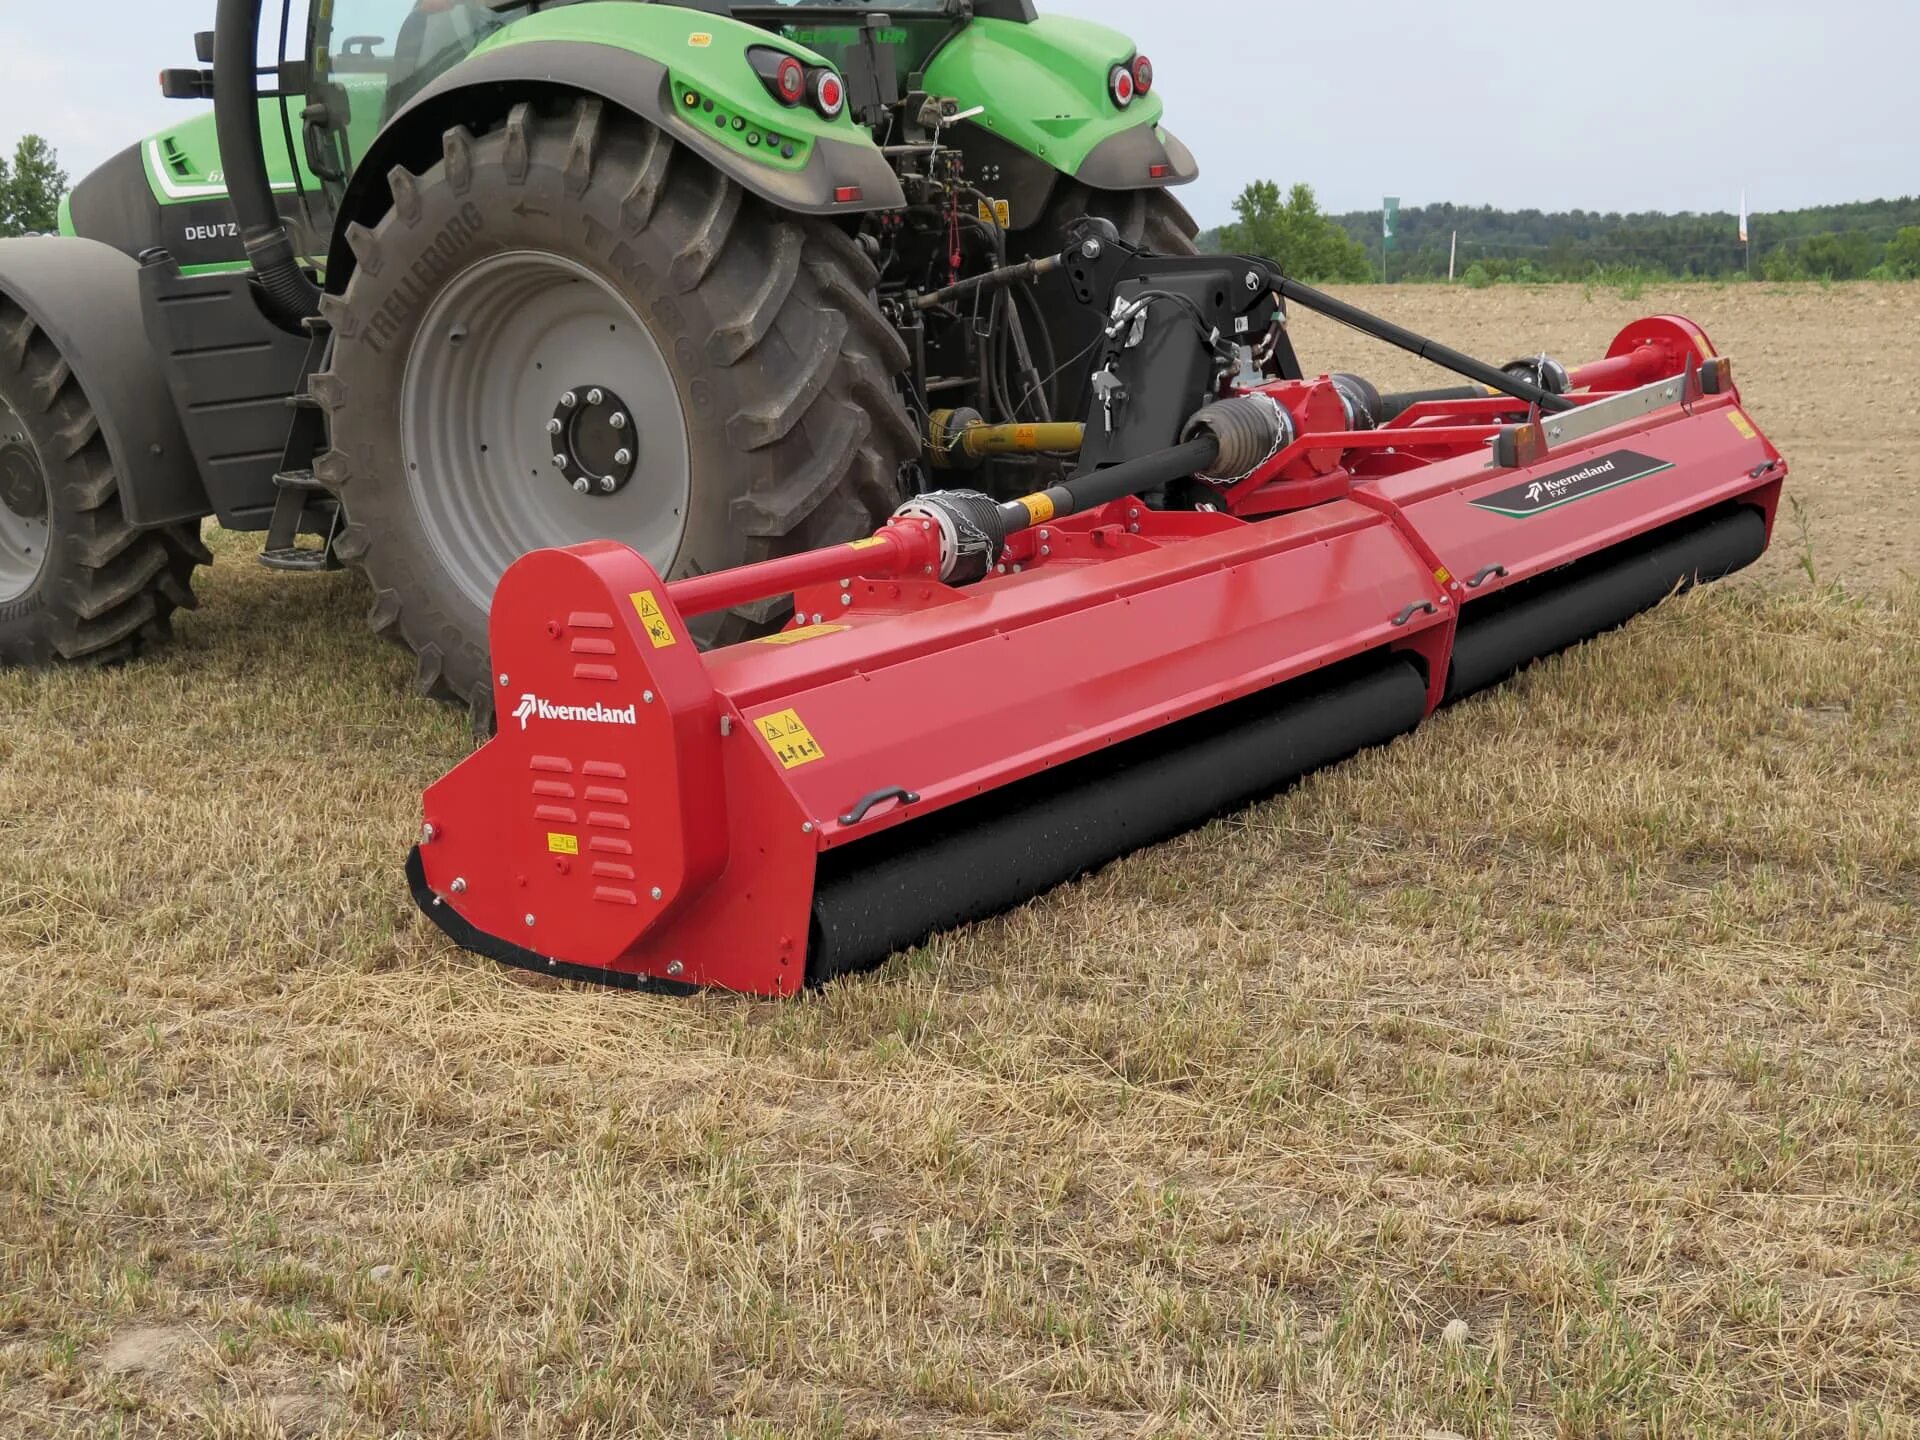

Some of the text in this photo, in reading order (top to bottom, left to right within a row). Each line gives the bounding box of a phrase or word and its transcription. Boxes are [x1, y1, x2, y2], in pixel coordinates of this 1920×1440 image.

[184, 222, 240, 241] DEUTZ
[361, 201, 484, 353] TRELLEBORG
[1543, 460, 1615, 491] Kverneland
[1549, 486, 1569, 498] FXF
[537, 699, 637, 724] Kverneland
